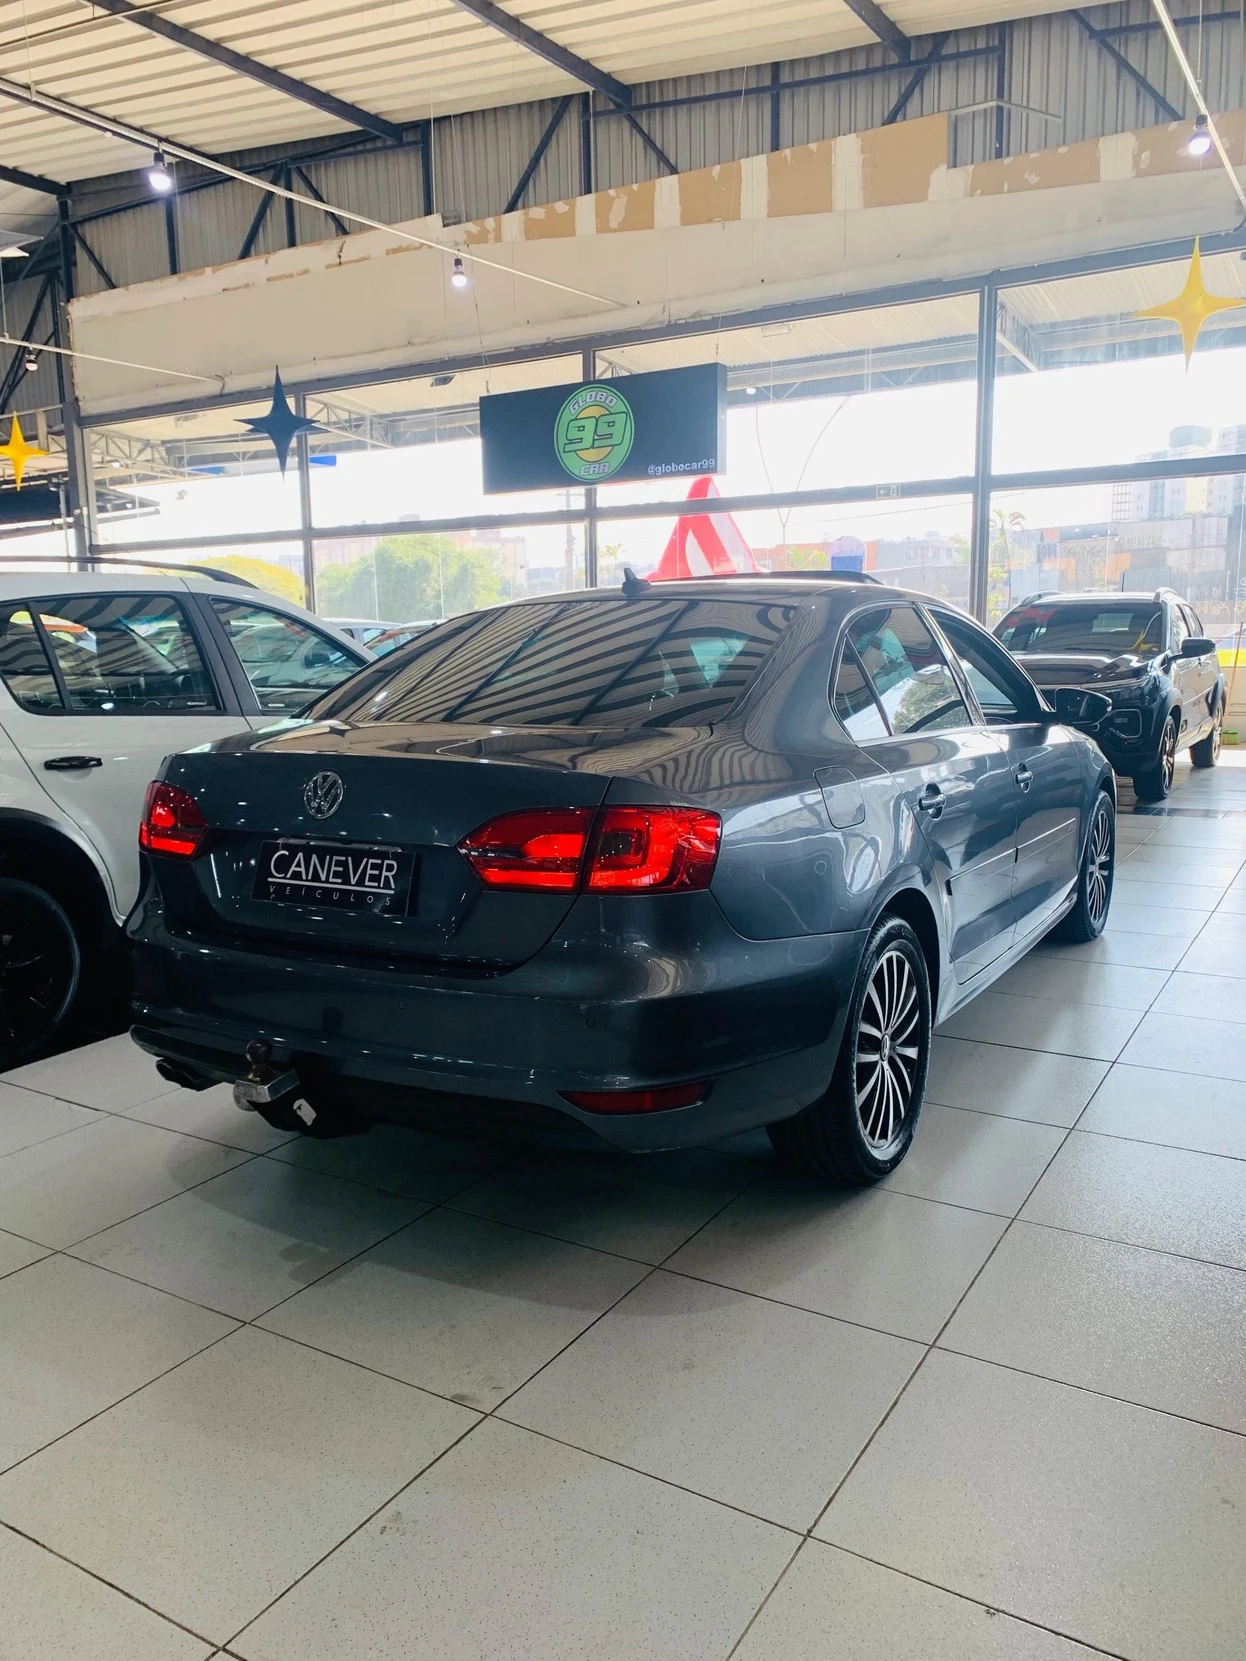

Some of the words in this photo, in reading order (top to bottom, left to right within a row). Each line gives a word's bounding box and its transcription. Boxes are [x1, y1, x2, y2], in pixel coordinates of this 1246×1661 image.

[569, 390, 618, 416] GLOBO
[563, 411, 628, 453] 99
[580, 462, 610, 476] CAR
[648, 458, 716, 476] @globocar99
[270, 850, 398, 889] CANEVER
